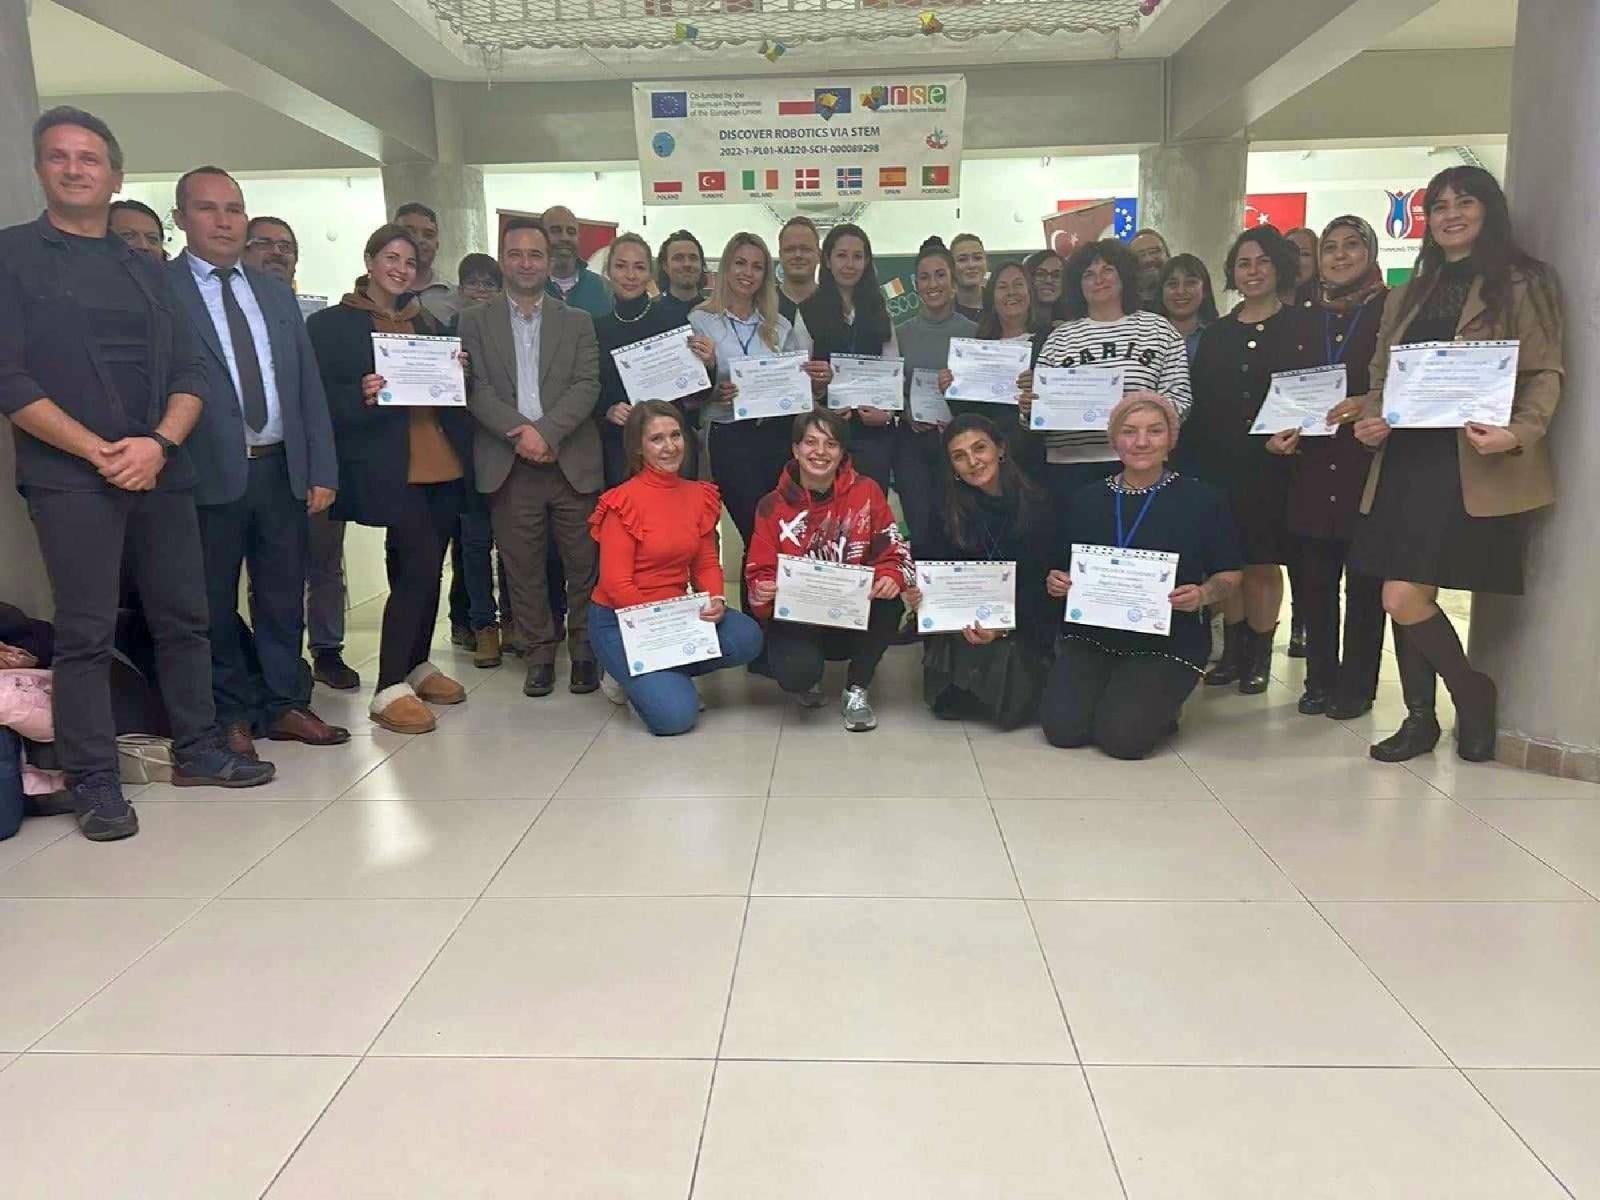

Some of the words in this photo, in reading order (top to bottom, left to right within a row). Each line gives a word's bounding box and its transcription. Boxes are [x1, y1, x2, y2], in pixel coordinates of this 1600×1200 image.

[719, 129, 773, 140] DISCOVER
[775, 128, 828, 139] ROBOTICS
[830, 127, 848, 137] VIA
[851, 126, 880, 136] STEM
